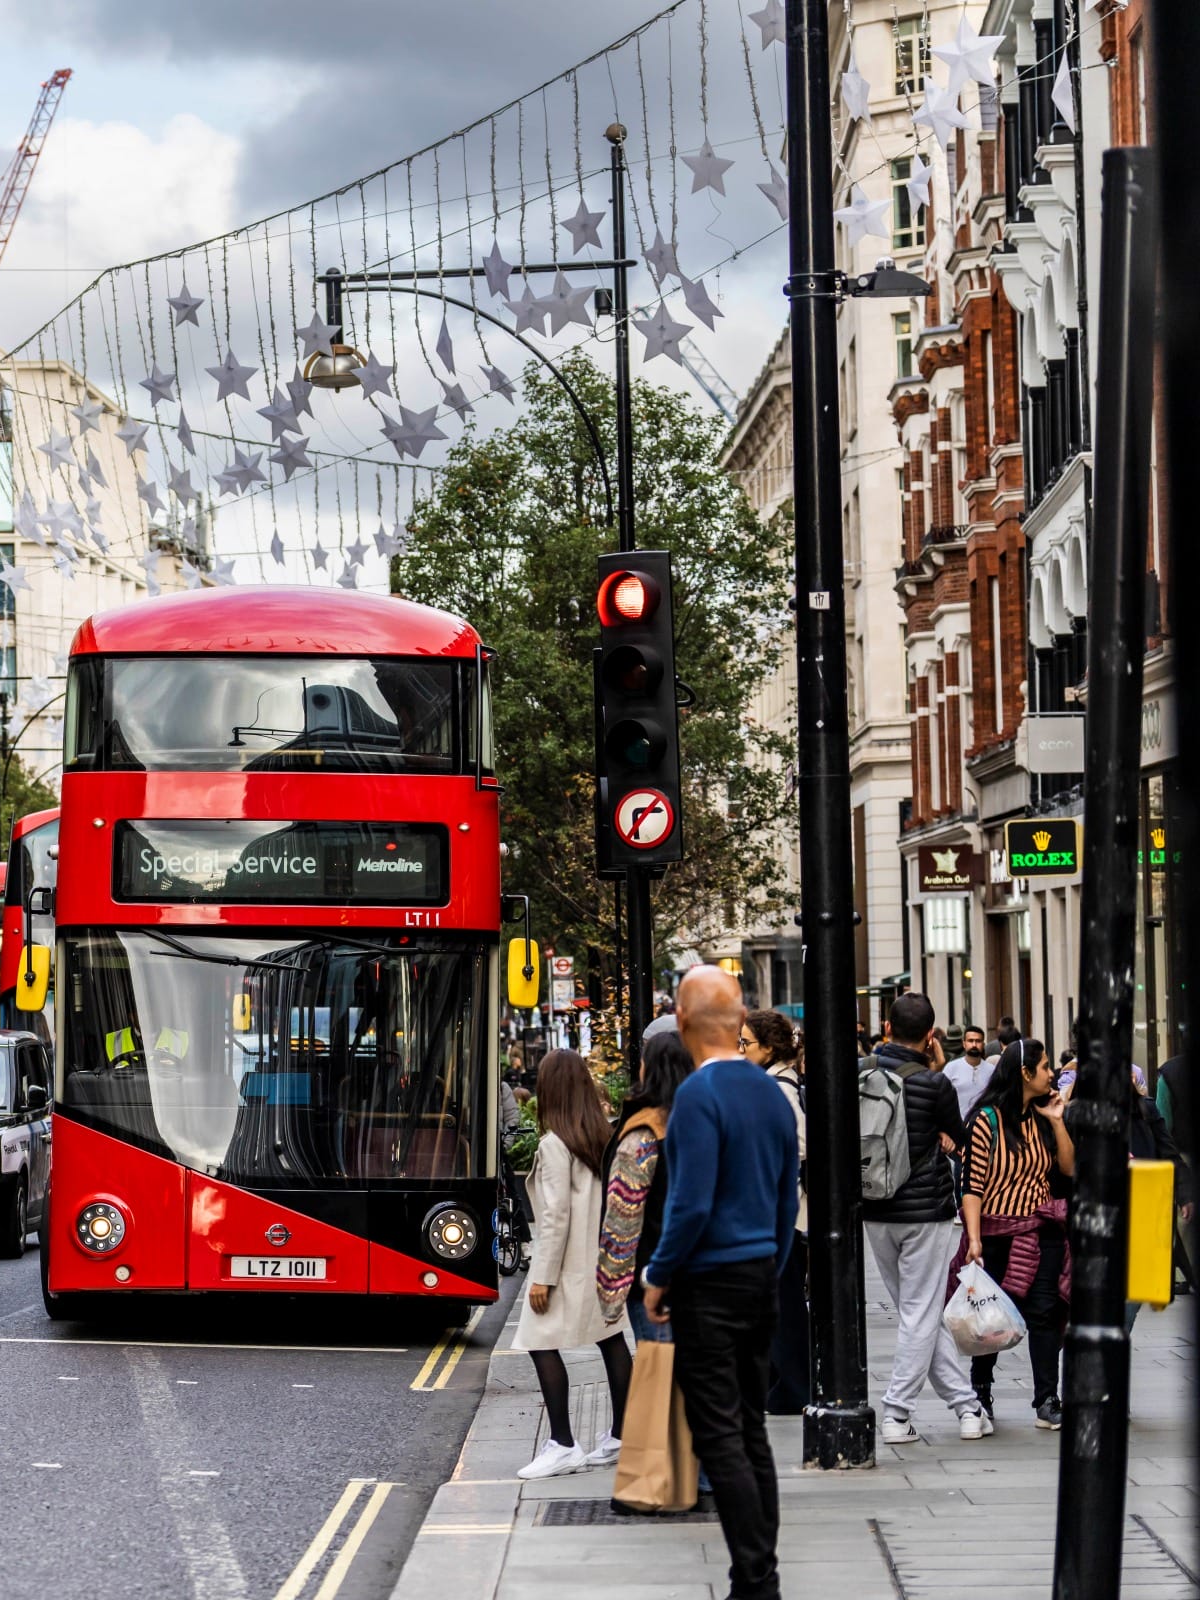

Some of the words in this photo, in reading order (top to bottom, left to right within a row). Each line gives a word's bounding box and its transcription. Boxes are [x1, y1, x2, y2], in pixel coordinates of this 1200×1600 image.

[140, 849, 224, 880] Special
[231, 850, 317, 875] Service
[357, 858, 424, 873] Metroline
[1011, 852, 1074, 867] ROLEX
[924, 875, 953, 885] Arabian
[955, 875, 970, 884] Oud
[405, 911, 440, 927] LT11
[248, 1260, 281, 1276] LTZ
[289, 1260, 316, 1277] 1011
